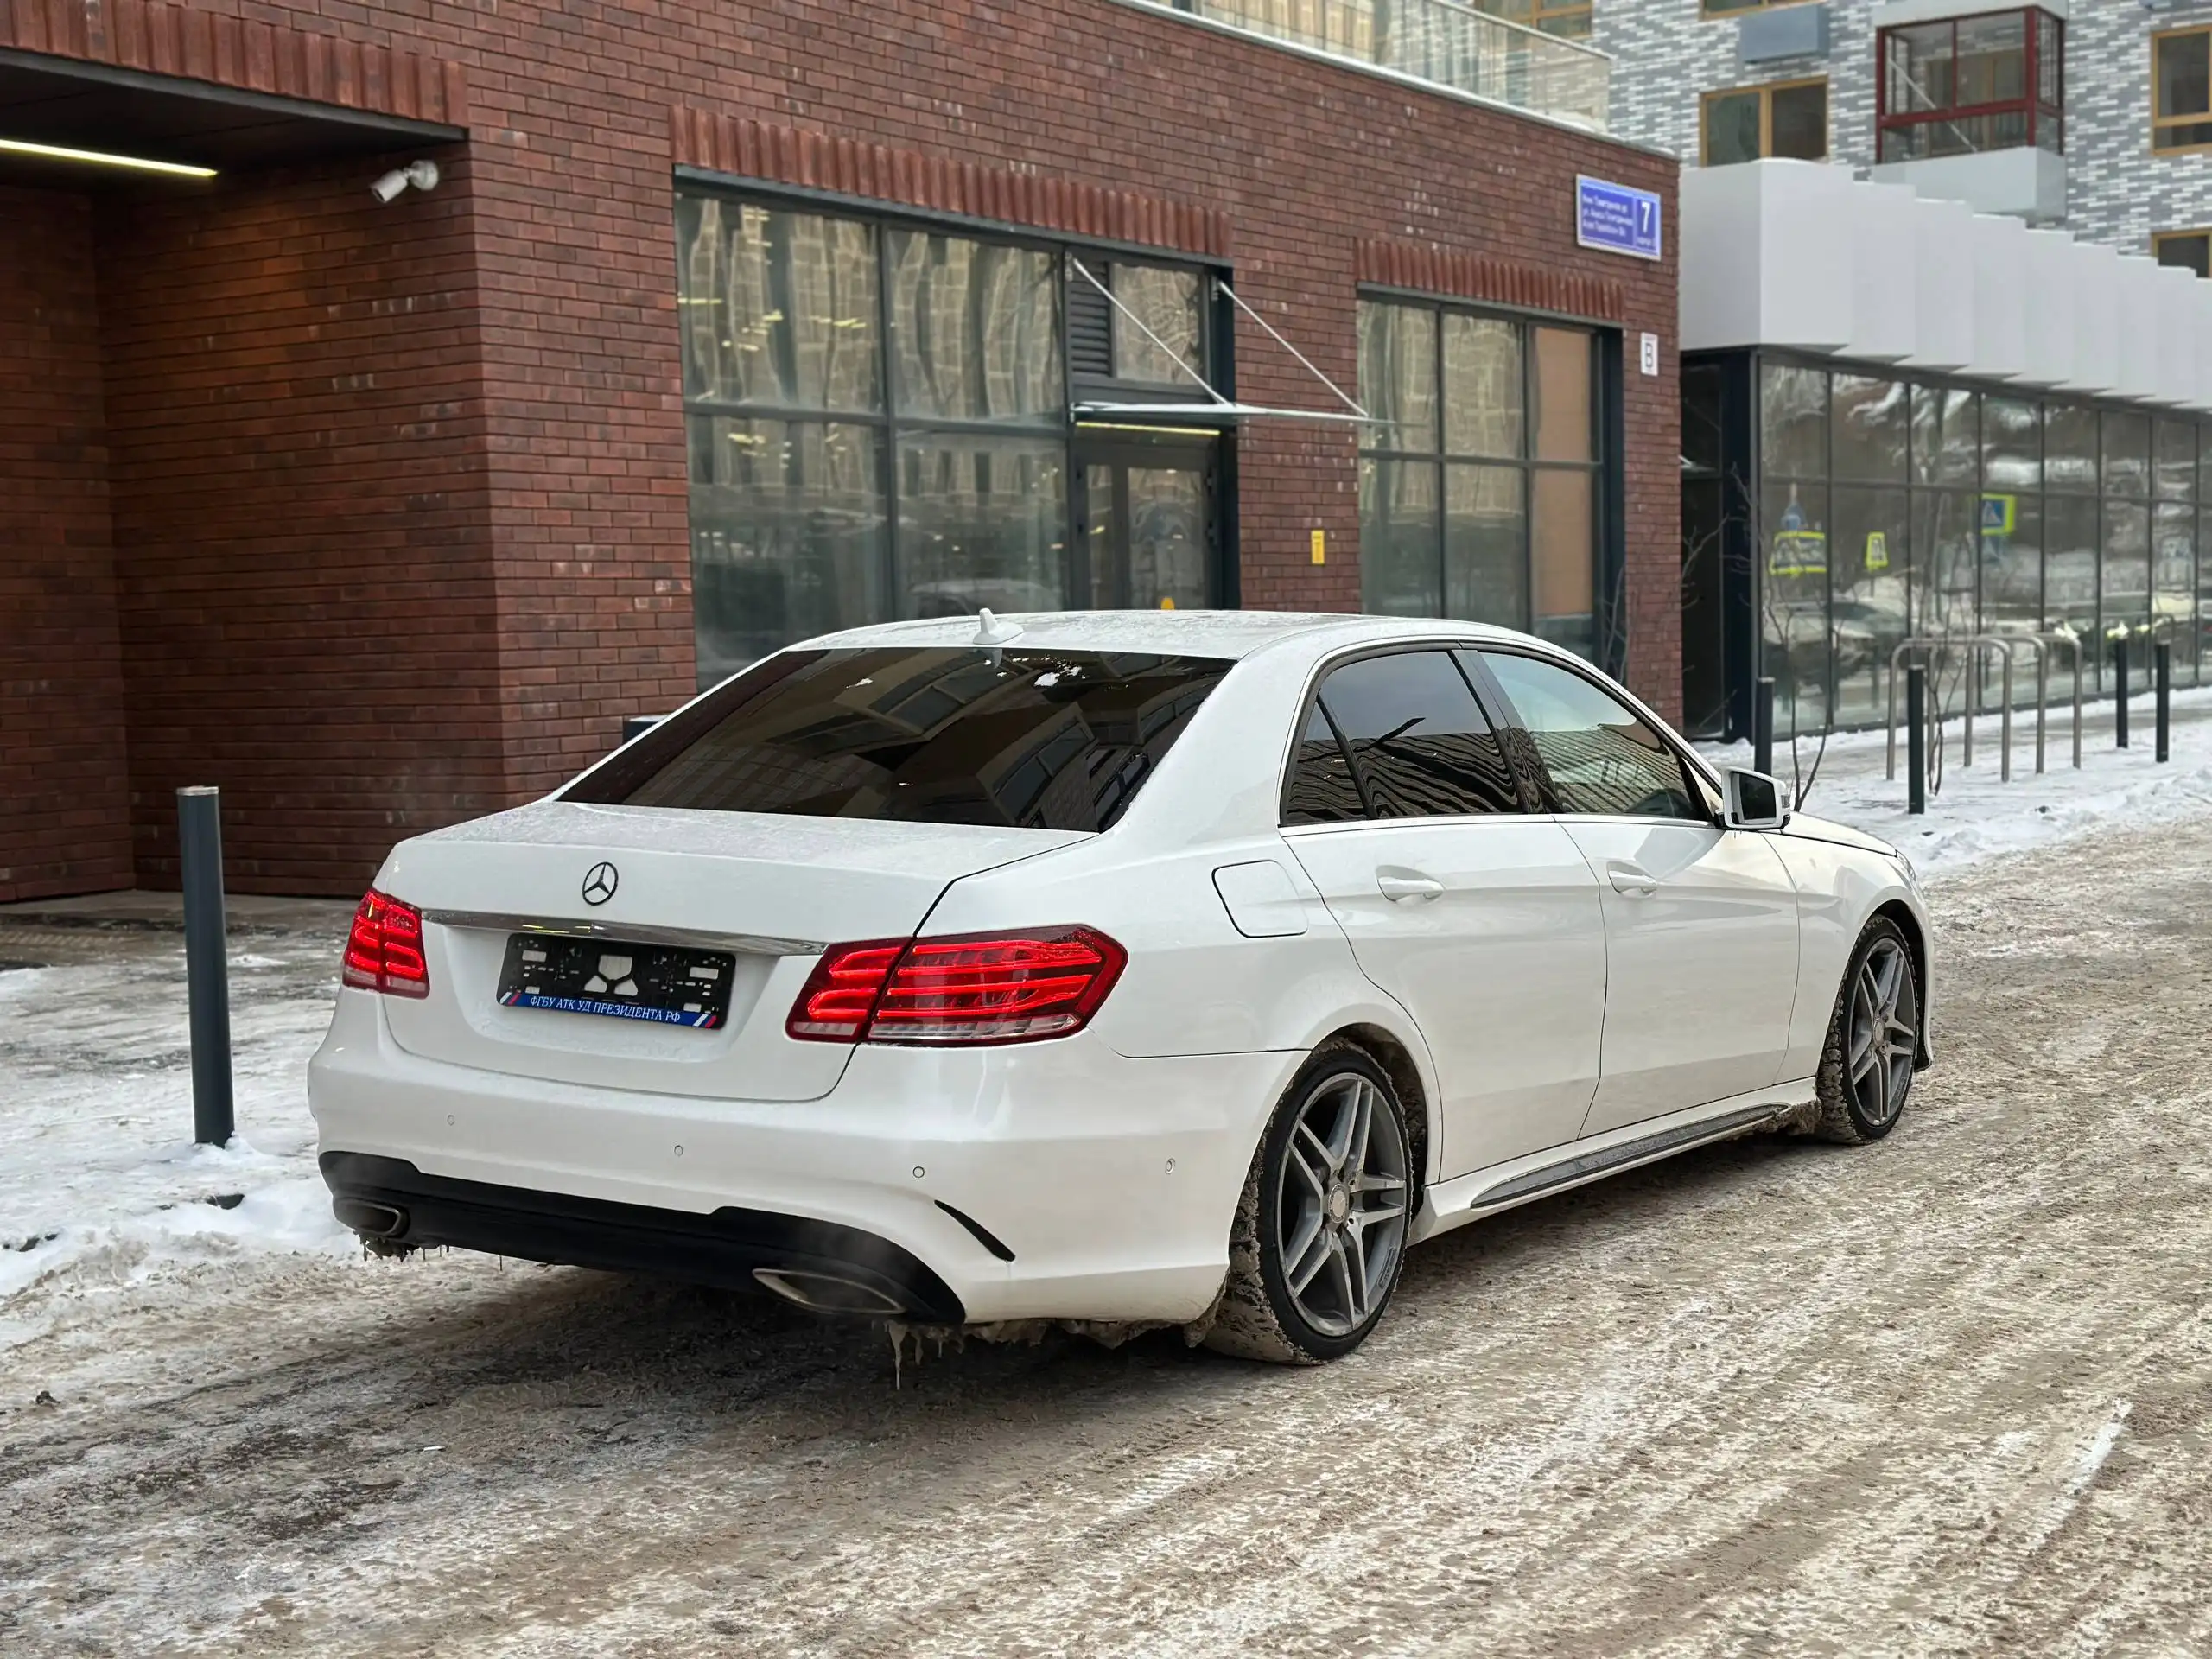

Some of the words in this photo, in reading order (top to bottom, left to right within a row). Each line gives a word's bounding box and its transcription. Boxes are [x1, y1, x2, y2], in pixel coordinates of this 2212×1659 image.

[1642, 201, 1651, 234] 7
[530, 995, 556, 1009] ФГБУ
[556, 997, 575, 1010] АТК
[576, 1000, 592, 1013] УД
[593, 1001, 663, 1020] ПРЕЗИДЕНТА
[665, 1010, 681, 1023] РФ
